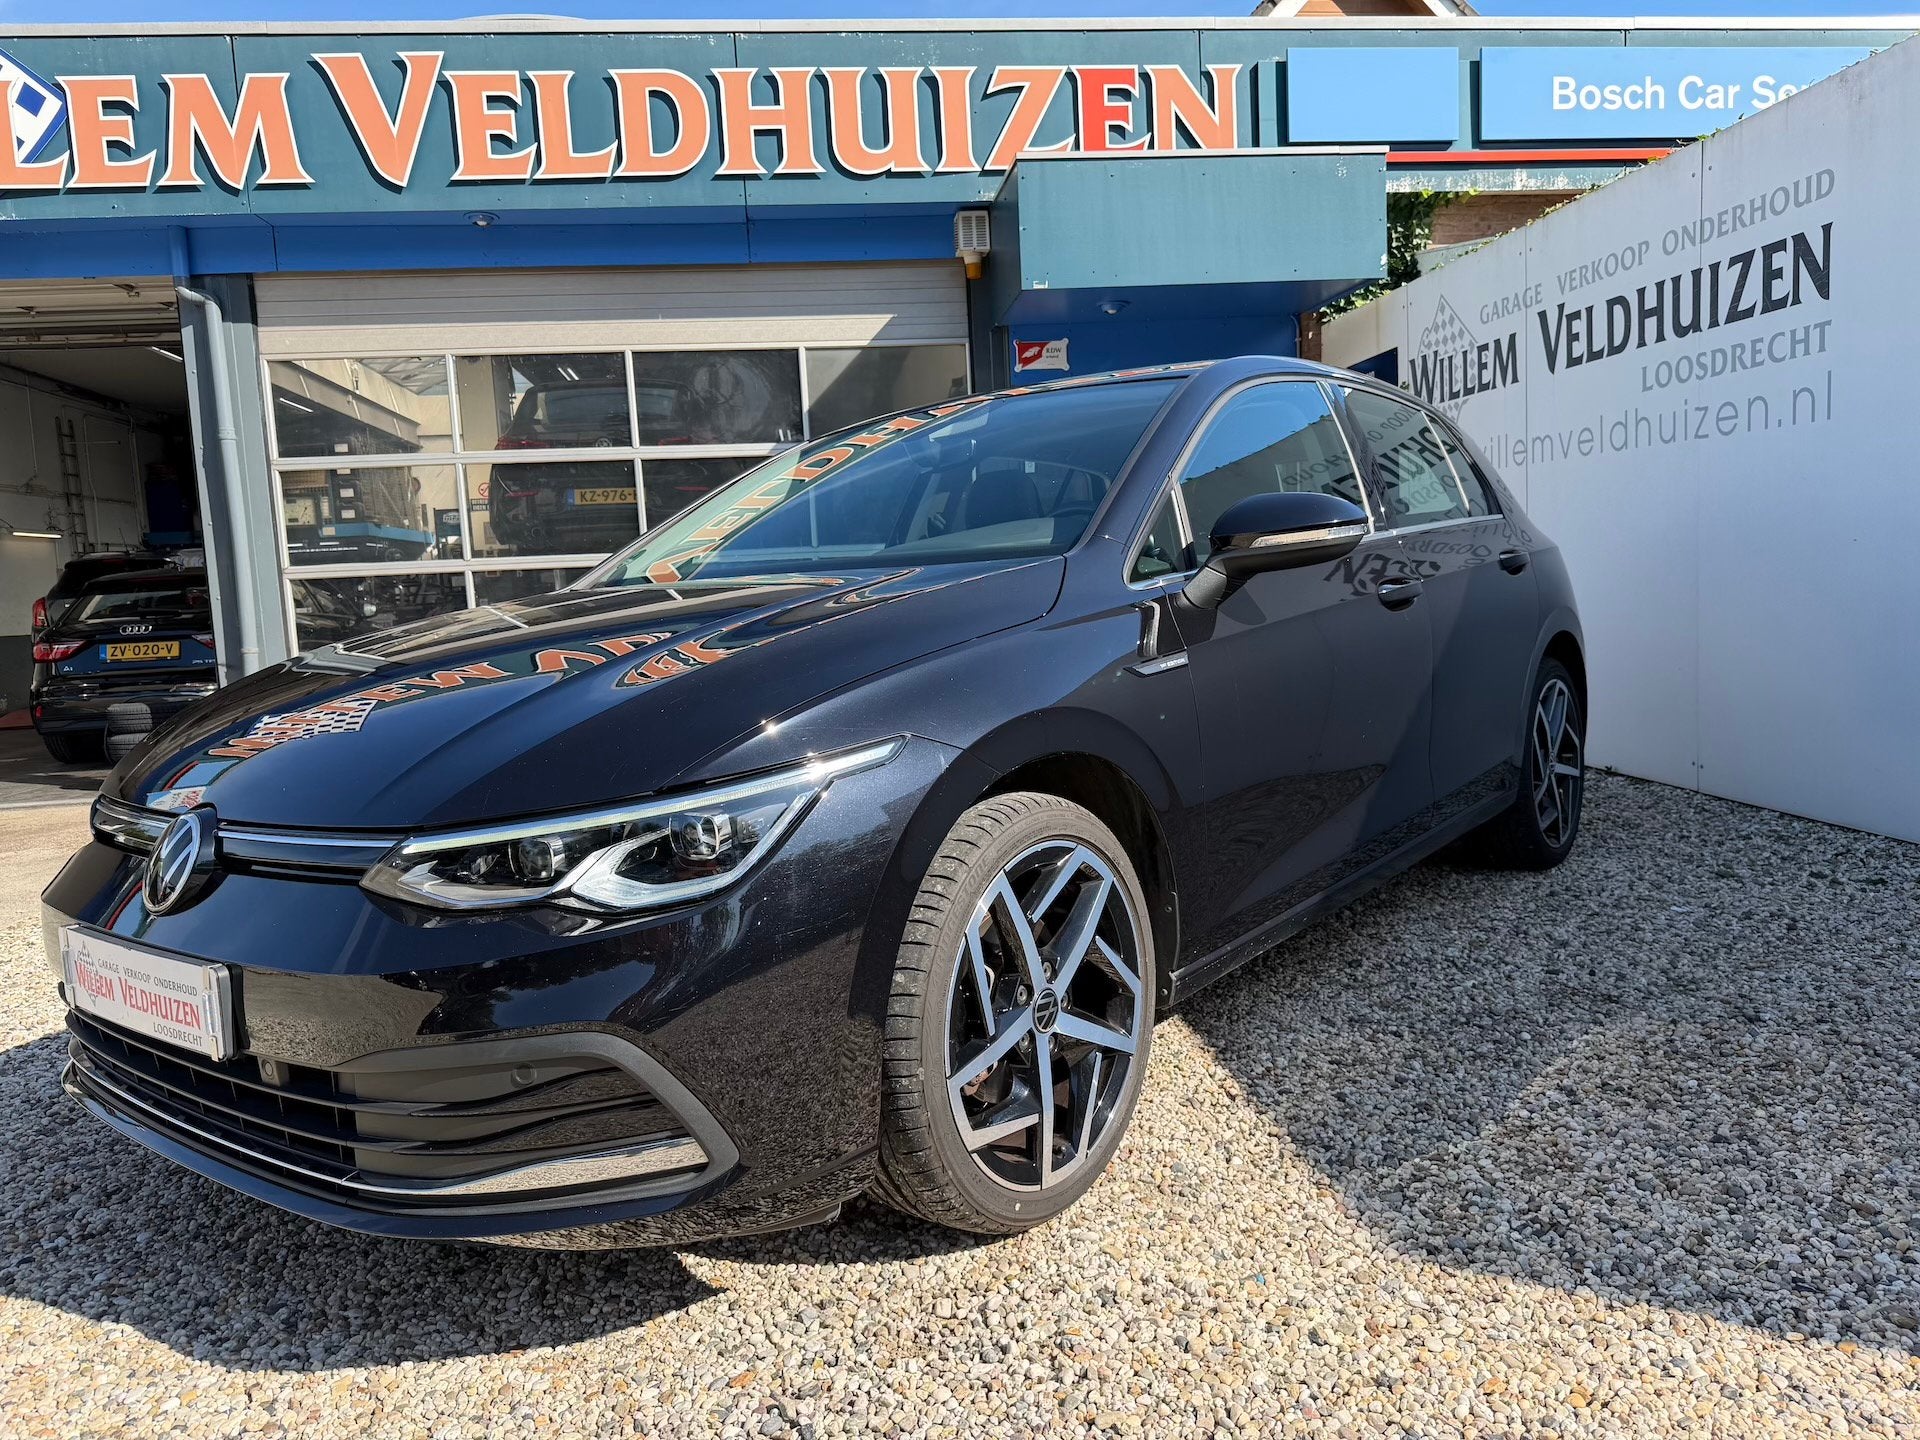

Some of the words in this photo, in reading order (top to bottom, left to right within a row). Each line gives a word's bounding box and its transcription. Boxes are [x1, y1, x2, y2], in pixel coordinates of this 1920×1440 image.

[310, 50, 1243, 189] VELDHUIZEN
[1552, 75, 1665, 110] Bosch
[1678, 75, 1741, 110] Car
[1480, 283, 1543, 325] GARAGE
[1557, 239, 1650, 296] VERKOOP
[1661, 168, 1835, 256] ONDERHOUD
[1409, 332, 1520, 405] WILLEM
[1537, 221, 1834, 375] VELDHUIZEN
[1641, 319, 1833, 393] LOOSDRECHT
[1483, 370, 1832, 469] illemveldhuizen.nl
[74, 959, 115, 1001] WILLEM
[118, 977, 201, 1031] VELDHUIZEN
[98, 958, 120, 974] GARAGE
[123, 966, 151, 984] VERKOOP
[154, 976, 198, 997] ONDERHOUD
[153, 1022, 203, 1047] LOOSDRECHT
